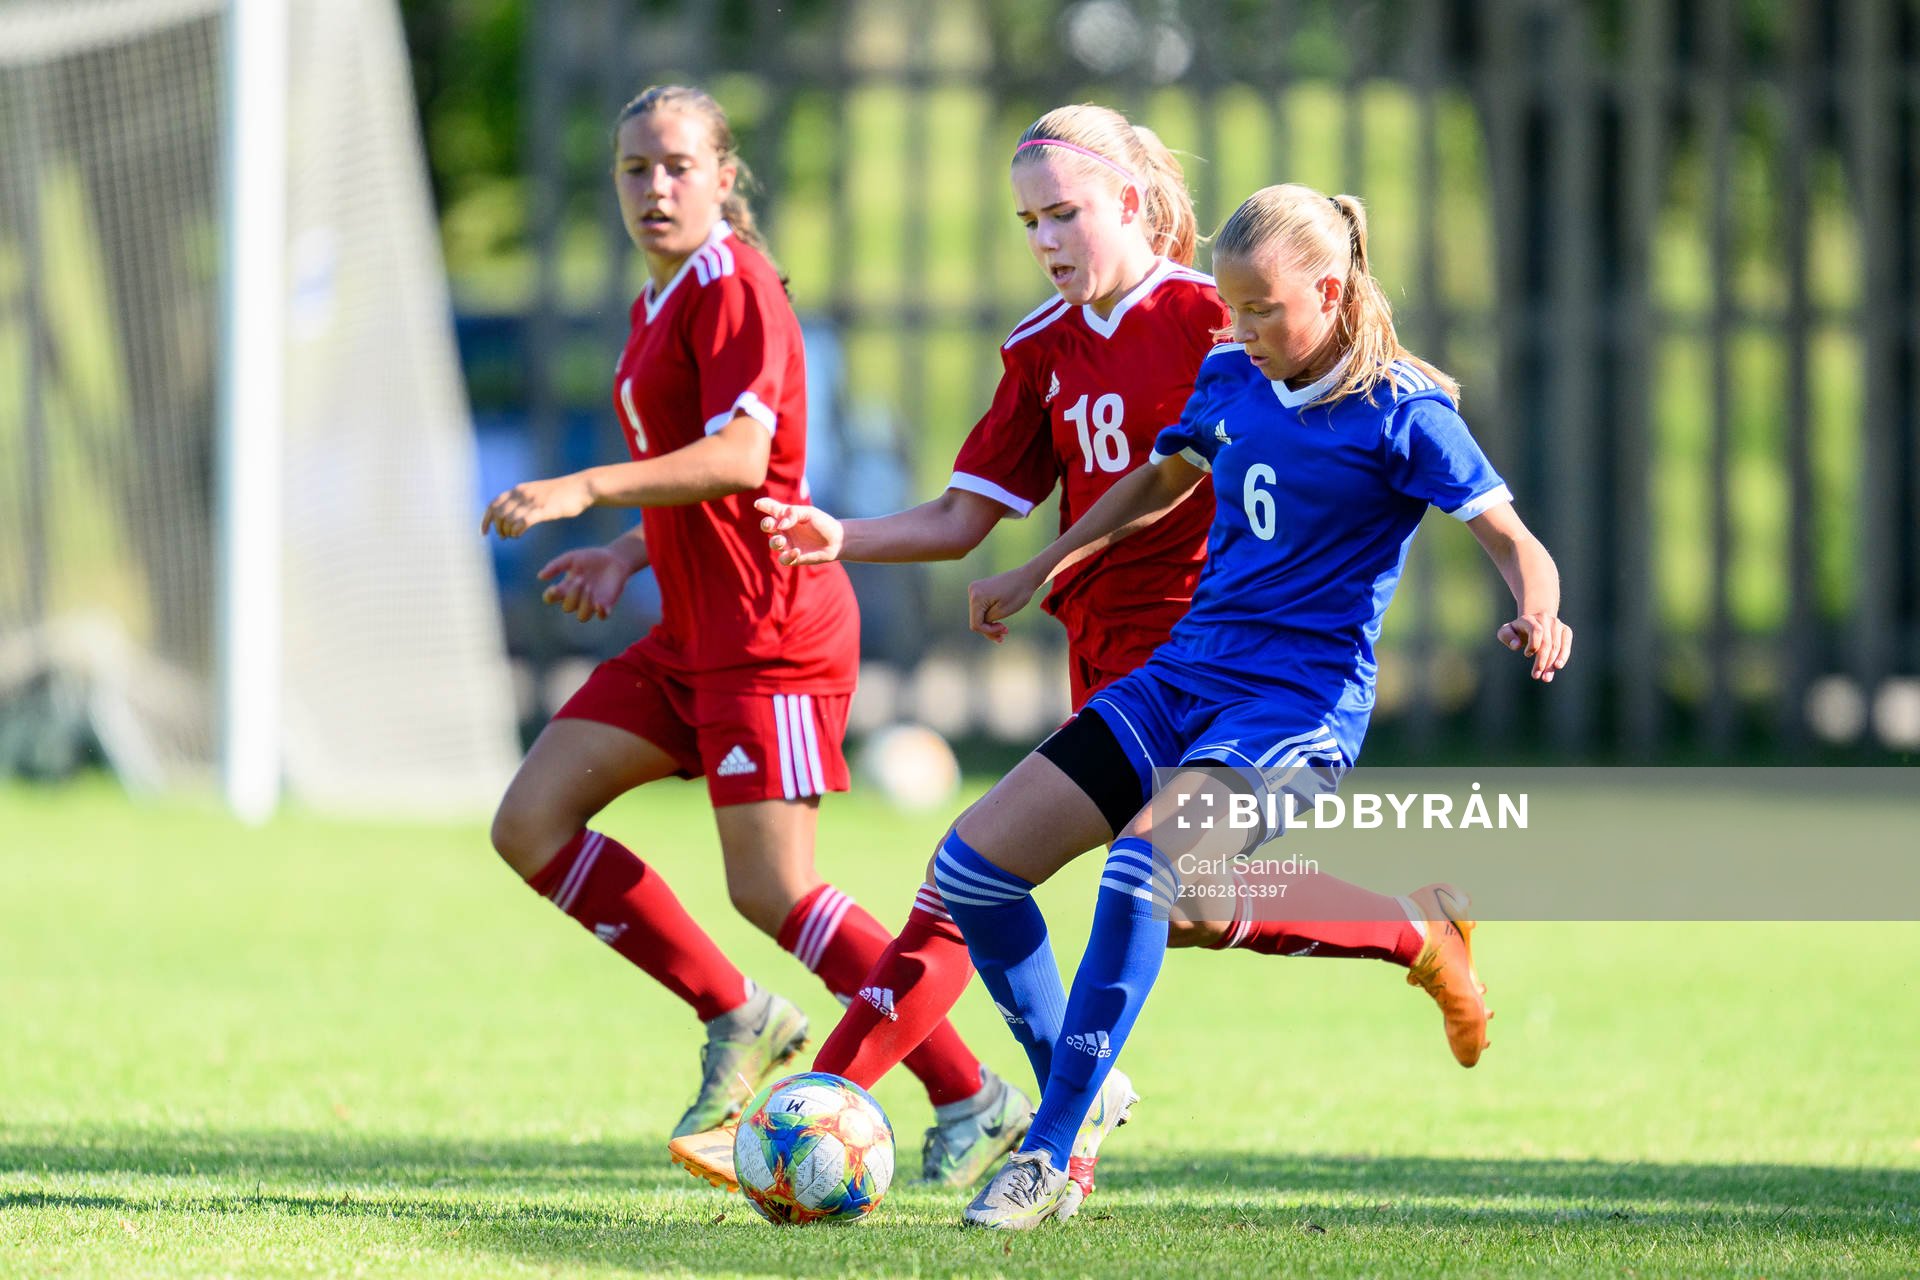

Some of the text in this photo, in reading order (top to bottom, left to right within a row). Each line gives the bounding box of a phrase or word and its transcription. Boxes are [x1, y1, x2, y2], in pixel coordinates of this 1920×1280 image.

[1064, 393, 1130, 473] 18
[1244, 463, 1277, 541] 6
[858, 989, 898, 1022] adidas
[1066, 1036, 1112, 1058] adidas
